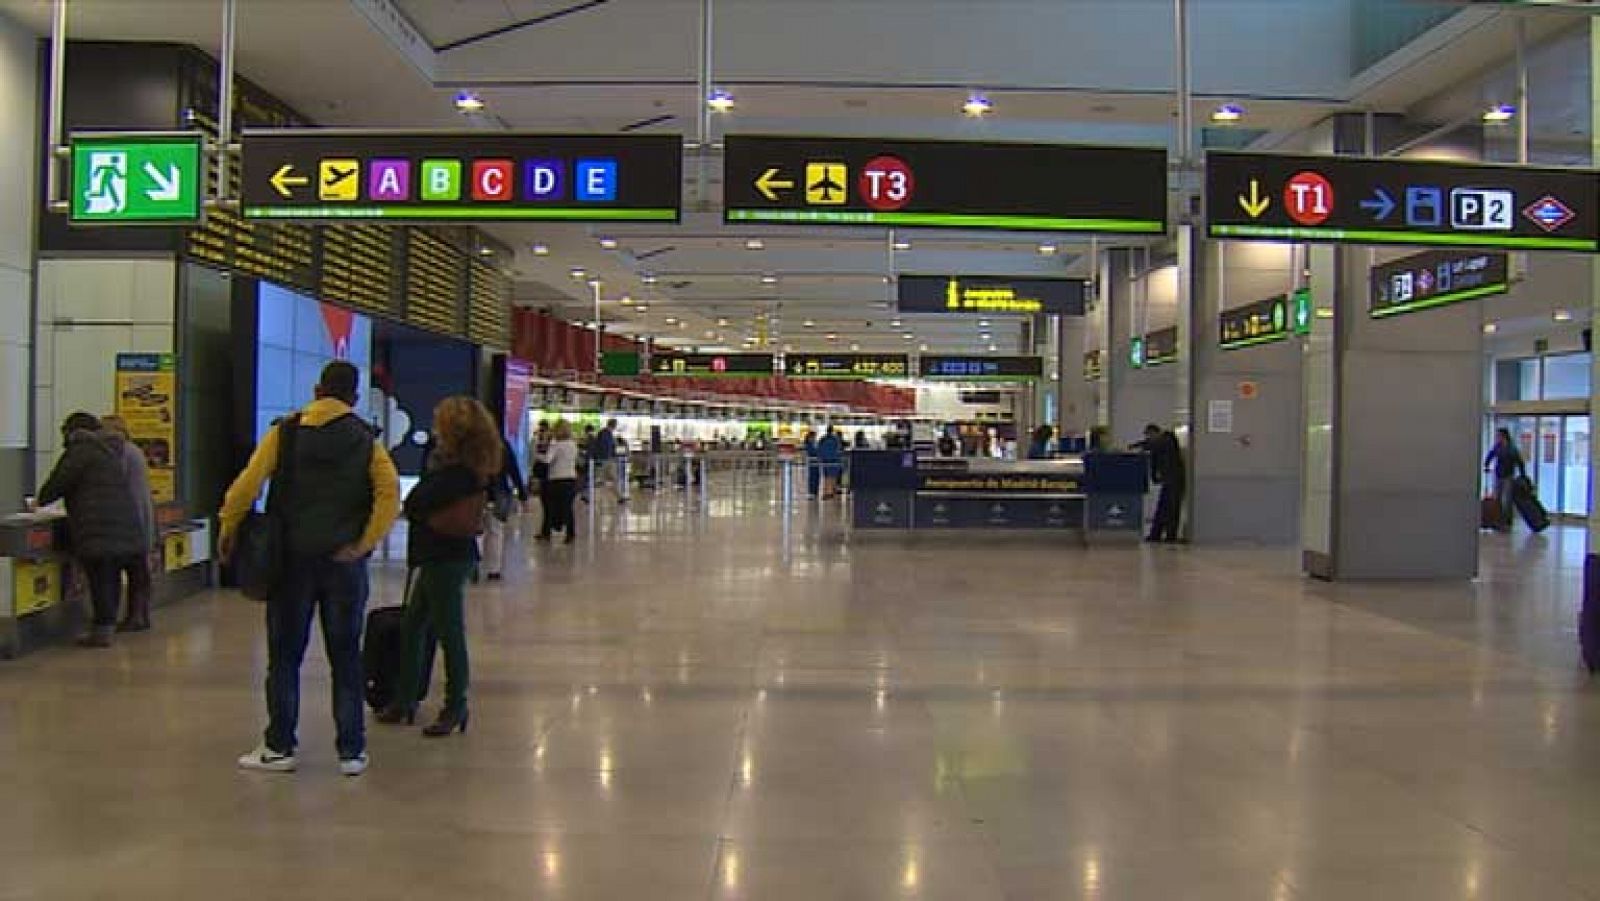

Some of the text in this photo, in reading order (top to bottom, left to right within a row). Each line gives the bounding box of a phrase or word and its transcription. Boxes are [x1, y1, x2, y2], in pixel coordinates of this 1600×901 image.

[378, 166, 606, 195] A B C D E
[864, 170, 907, 201] T3
[1290, 183, 1329, 214] T1
